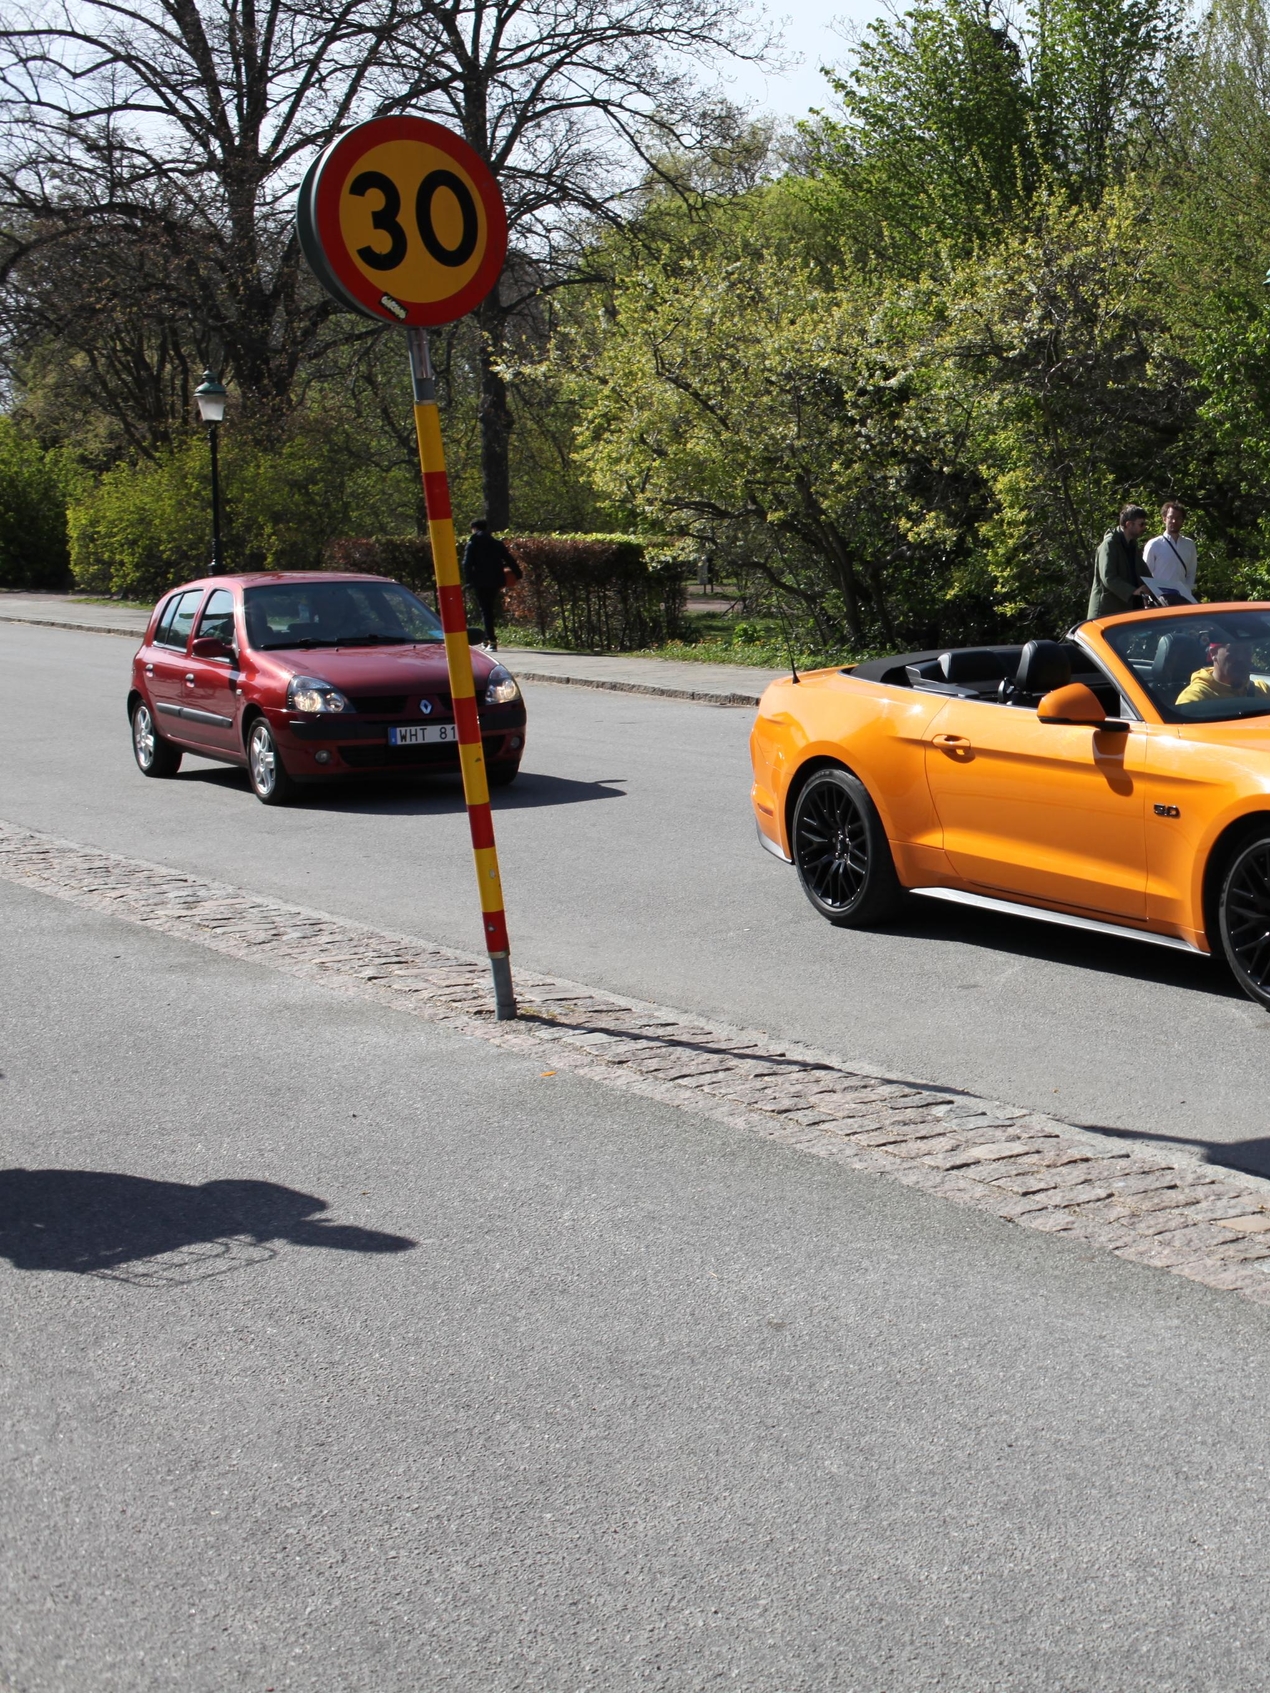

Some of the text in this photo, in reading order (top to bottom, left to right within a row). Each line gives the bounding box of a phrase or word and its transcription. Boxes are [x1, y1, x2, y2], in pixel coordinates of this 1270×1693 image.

[349, 169, 478, 271] 30
[399, 725, 456, 743] WHT 81
